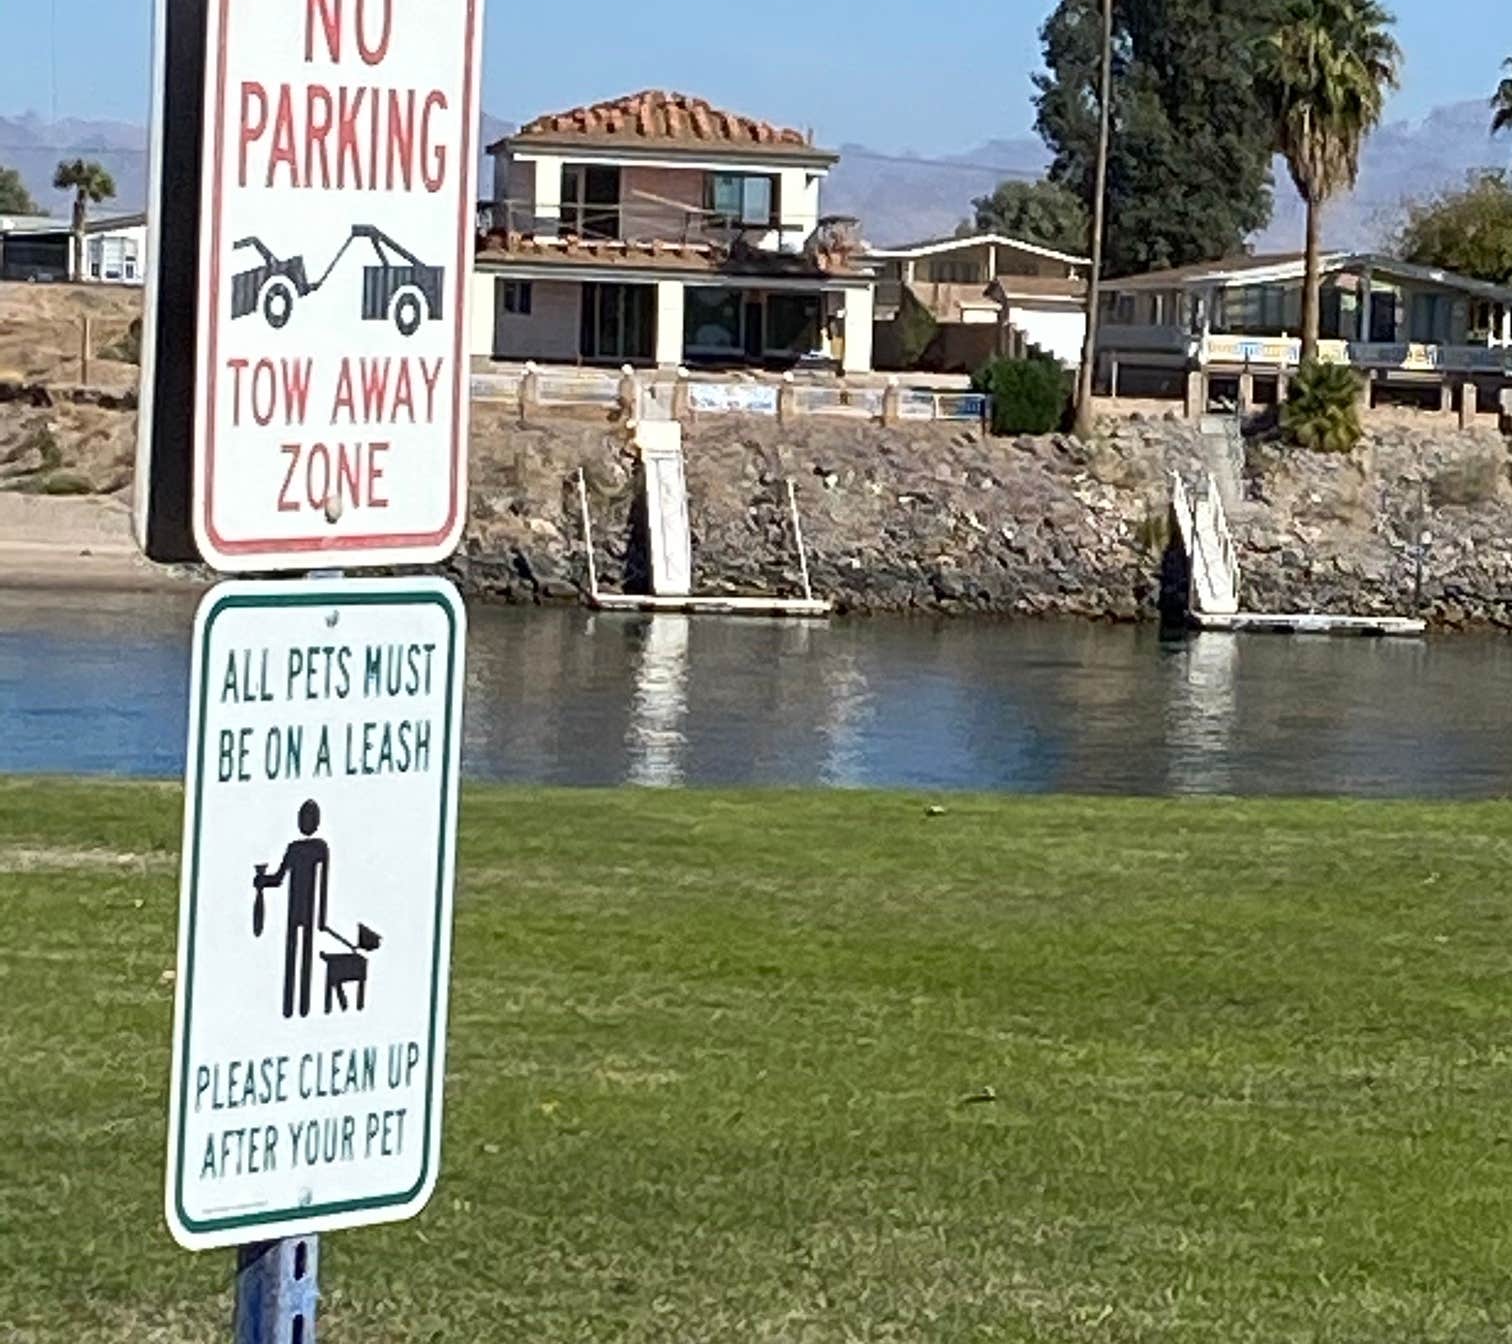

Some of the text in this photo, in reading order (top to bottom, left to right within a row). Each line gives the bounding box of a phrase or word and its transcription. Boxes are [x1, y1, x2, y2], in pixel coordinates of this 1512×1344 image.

[238, 81, 449, 193] PARKING
[227, 356, 443, 426] TOW AWAY
[276, 442, 390, 512] ZONE
[221, 643, 436, 703] ALL PETS MUST
[217, 720, 431, 783] BE ON A LEASH
[195, 1041, 420, 1112] PLEASE CLEAN UP
[200, 1107, 407, 1180] AFTER YOUR PET
